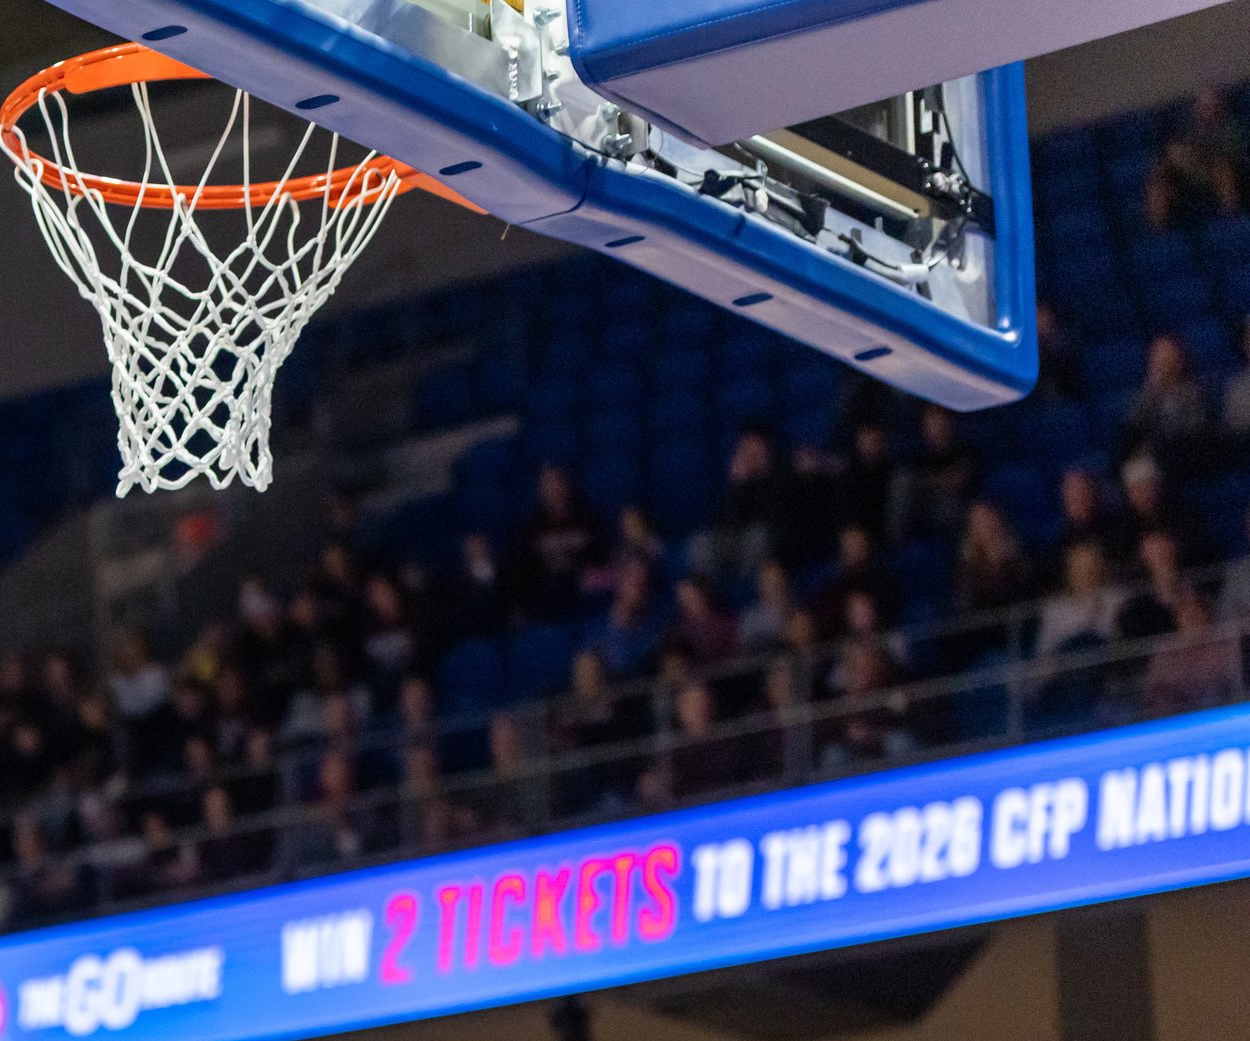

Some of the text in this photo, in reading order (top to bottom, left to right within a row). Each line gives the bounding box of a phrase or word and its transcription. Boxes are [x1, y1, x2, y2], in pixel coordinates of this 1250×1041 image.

[282, 911, 372, 992] WIN
[382, 892, 418, 983] 2
[438, 843, 680, 971] TICKETS
[694, 840, 753, 921] TO
[762, 821, 849, 908] THE
[991, 777, 1088, 868] CFP
[1097, 748, 1250, 850] NATIO
[66, 950, 142, 1034] GO
